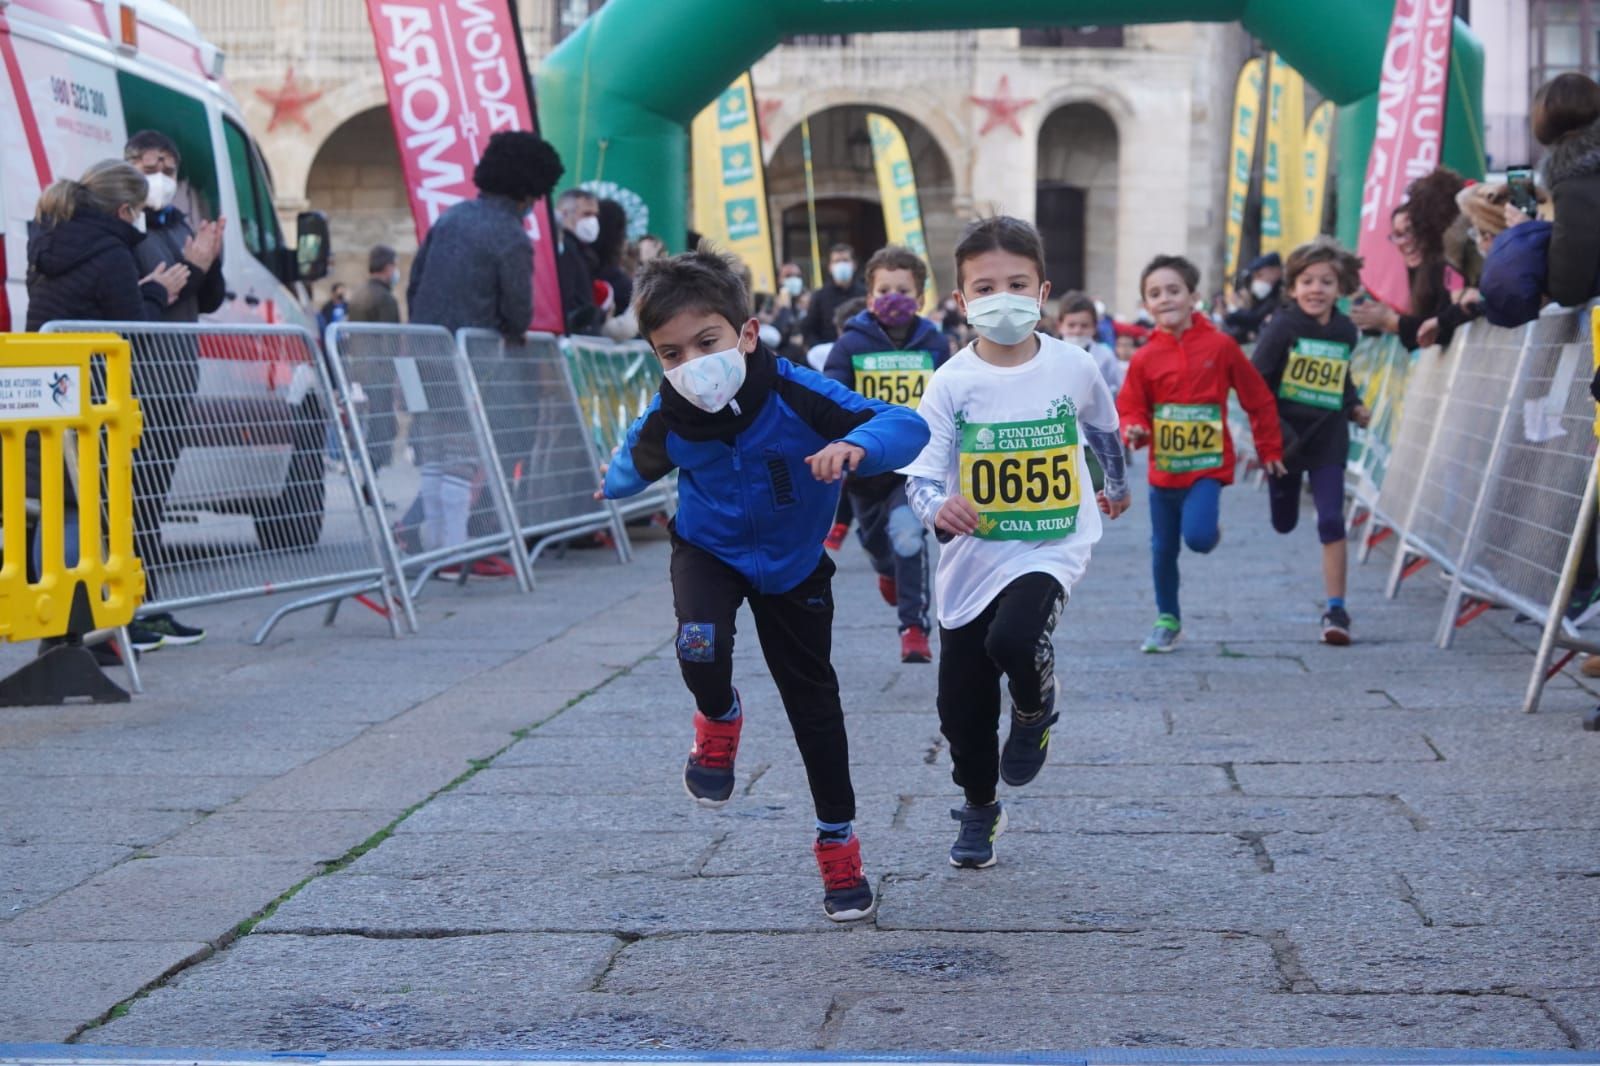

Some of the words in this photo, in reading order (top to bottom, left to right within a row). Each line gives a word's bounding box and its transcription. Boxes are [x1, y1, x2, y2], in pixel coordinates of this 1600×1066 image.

[1291, 358, 1342, 386] 0694
[863, 375, 924, 404] 0554
[998, 423, 1066, 439] FUNDACION
[999, 439, 1028, 450] CAJA
[1031, 435, 1066, 448] RURAL
[1160, 424, 1216, 452] 0642
[971, 454, 1072, 505] 0655
[1000, 519, 1033, 532] CAJA
